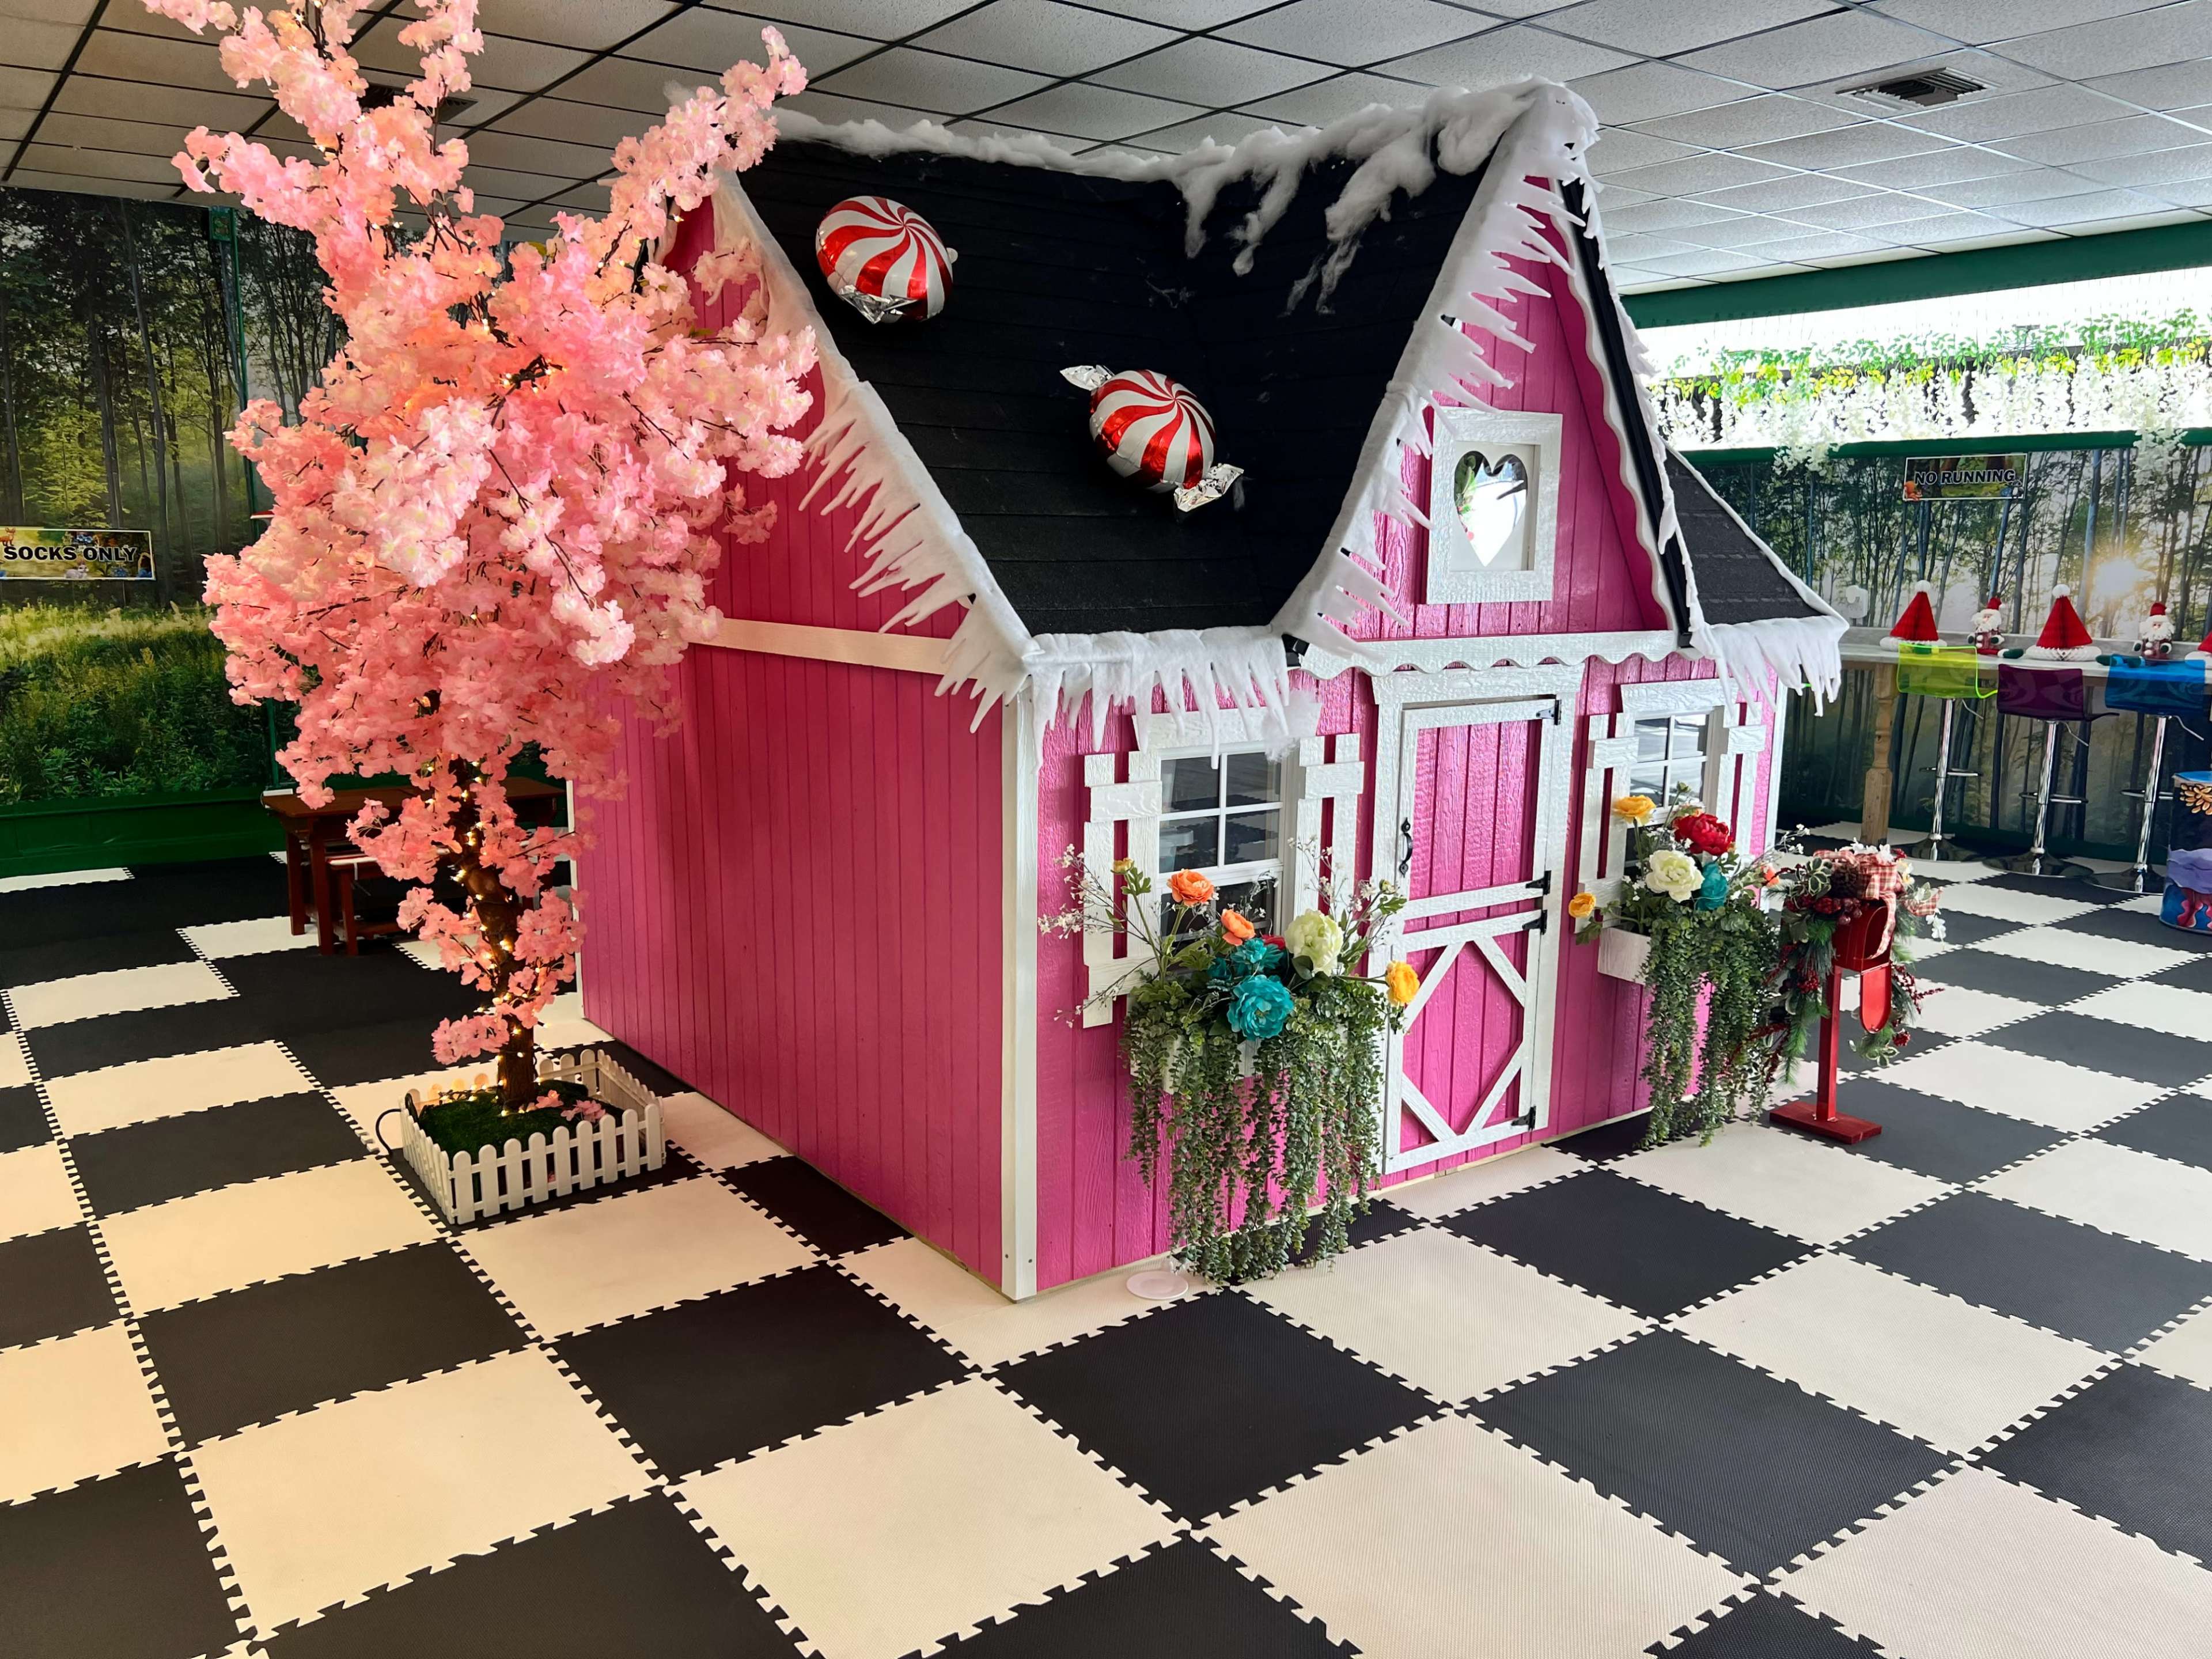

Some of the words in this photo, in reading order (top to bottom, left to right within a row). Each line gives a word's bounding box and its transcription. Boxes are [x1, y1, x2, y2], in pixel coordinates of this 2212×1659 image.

[1915, 472, 1937, 485] NO
[1941, 469, 2016, 484] RUNNING
[3, 546, 77, 561] SOCKS
[83, 547, 137, 562] ONLY
